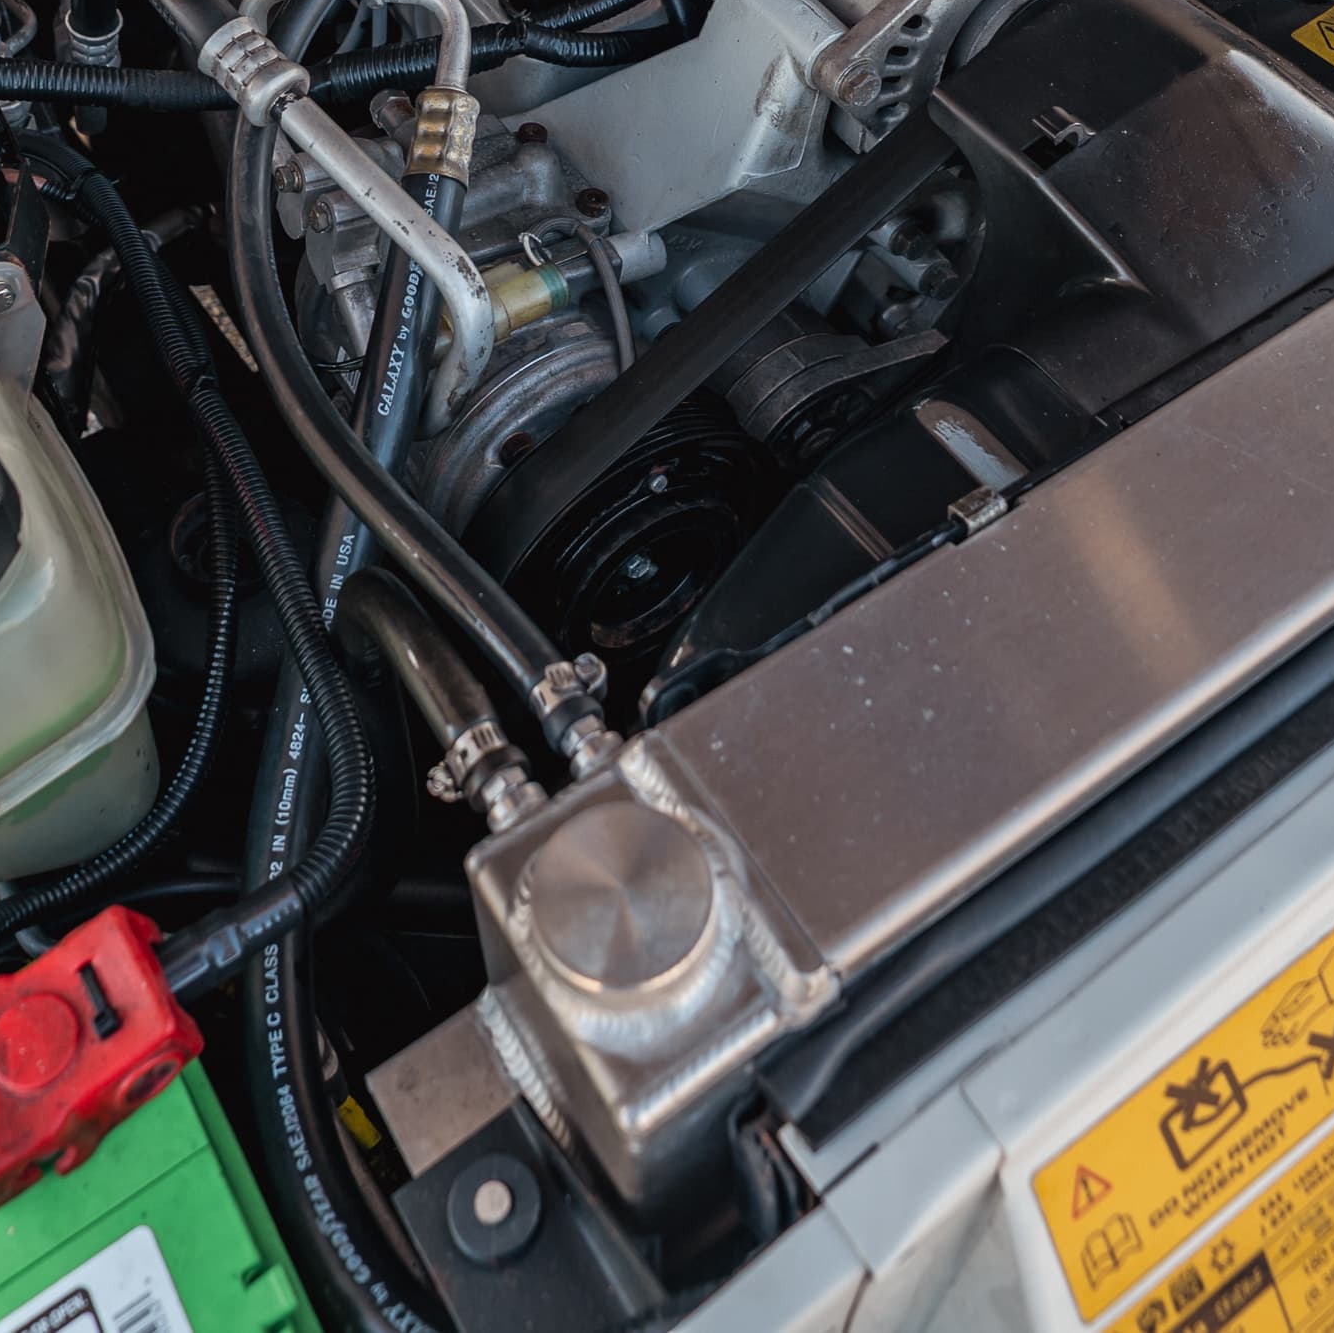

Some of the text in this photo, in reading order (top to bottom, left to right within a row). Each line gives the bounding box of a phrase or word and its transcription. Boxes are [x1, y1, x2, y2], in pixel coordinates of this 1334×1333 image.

[377, 345, 405, 417] GALAXY
[397, 324, 410, 341] by
[322, 533, 356, 632] ADE IN USA
[274, 767, 298, 826] (10mm)
[272, 834, 286, 853] IN
[265, 943, 279, 1003] CLASS
[267, 1012, 281, 1026] C
[269, 1028, 287, 1079] TYPE
[1148, 1087, 1309, 1228] DO NOT REMOVE
[1183, 1161, 1244, 1218] WHEN
[1247, 1124, 1286, 1164] HOT
